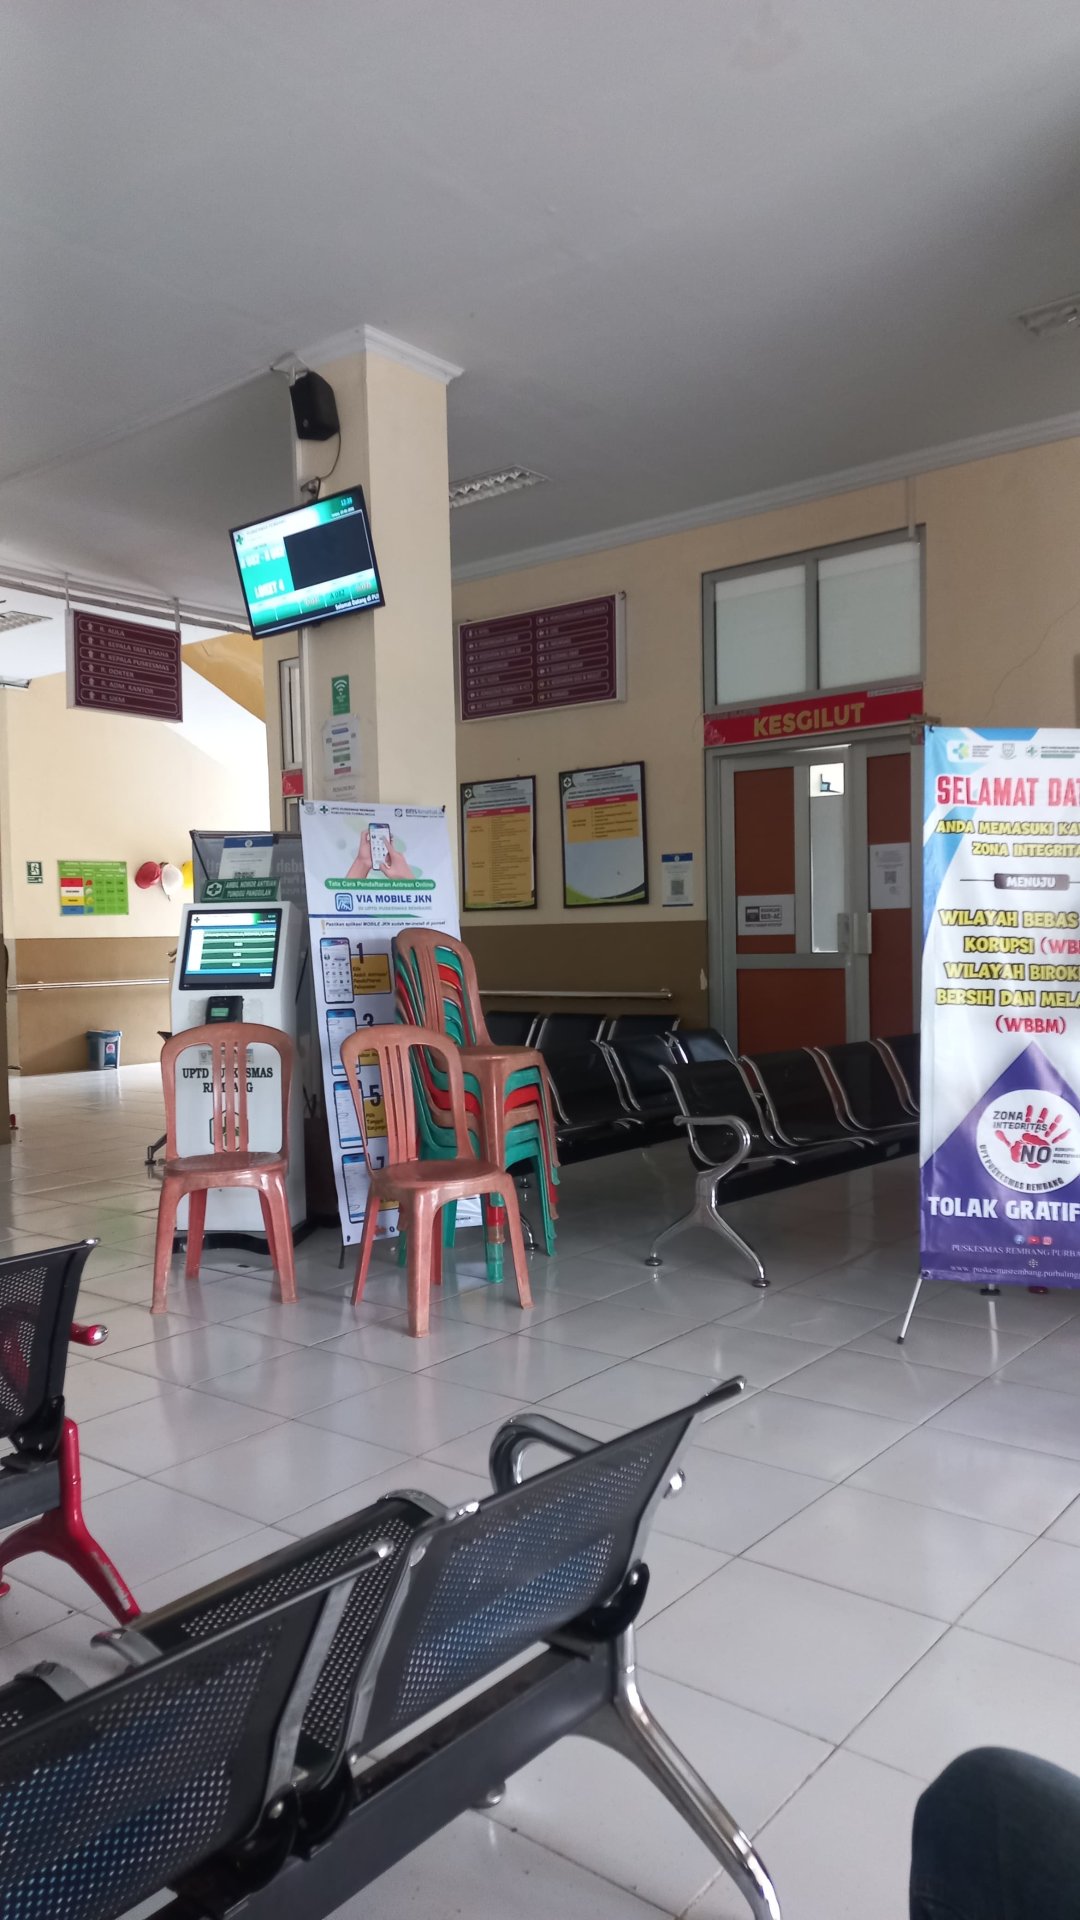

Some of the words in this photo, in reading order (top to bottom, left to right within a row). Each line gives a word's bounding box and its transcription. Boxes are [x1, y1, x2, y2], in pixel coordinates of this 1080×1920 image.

[754, 702, 865, 737] KESGILUT
[937, 775, 1039, 807] SELAMAT
[936, 820, 975, 834] ANDA
[978, 820, 1054, 836] MEMASUKI
[1057, 821, 1080, 836] KA
[972, 841, 1010, 856] ZONA
[1006, 876, 1056, 888] MENUJU
[356, 894, 373, 903] VIA
[376, 894, 412, 904] MOBILE
[414, 894, 432, 904] JKN
[939, 909, 1019, 928] WILAYAH
[1022, 911, 1080, 929] BEBAS
[356, 942, 364, 964] 1
[964, 936, 1036, 954] KORUPSI
[1040, 937, 1080, 955] (WB
[944, 962, 1025, 980] WILAYAH
[1029, 964, 1080, 981] BIROK
[936, 988, 996, 1006] BERSIH
[999, 989, 1036, 1007] DAN
[996, 1014, 1066, 1034] (WBBM)
[182, 1068, 209, 1078] UPTD
[369, 1084, 380, 1106] 5
[993, 1110, 1023, 1120] ZONA
[993, 1122, 1048, 1132] INTEGRITAS
[1020, 1145, 1052, 1164] NO
[1026, 1177, 1064, 1191] REMBANG
[928, 1196, 998, 1218] TOLAK
[1005, 1200, 1080, 1222] GRATIF
[952, 1244, 1004, 1254] PUSKESMAS
[1006, 1247, 1050, 1256] REMBANG
